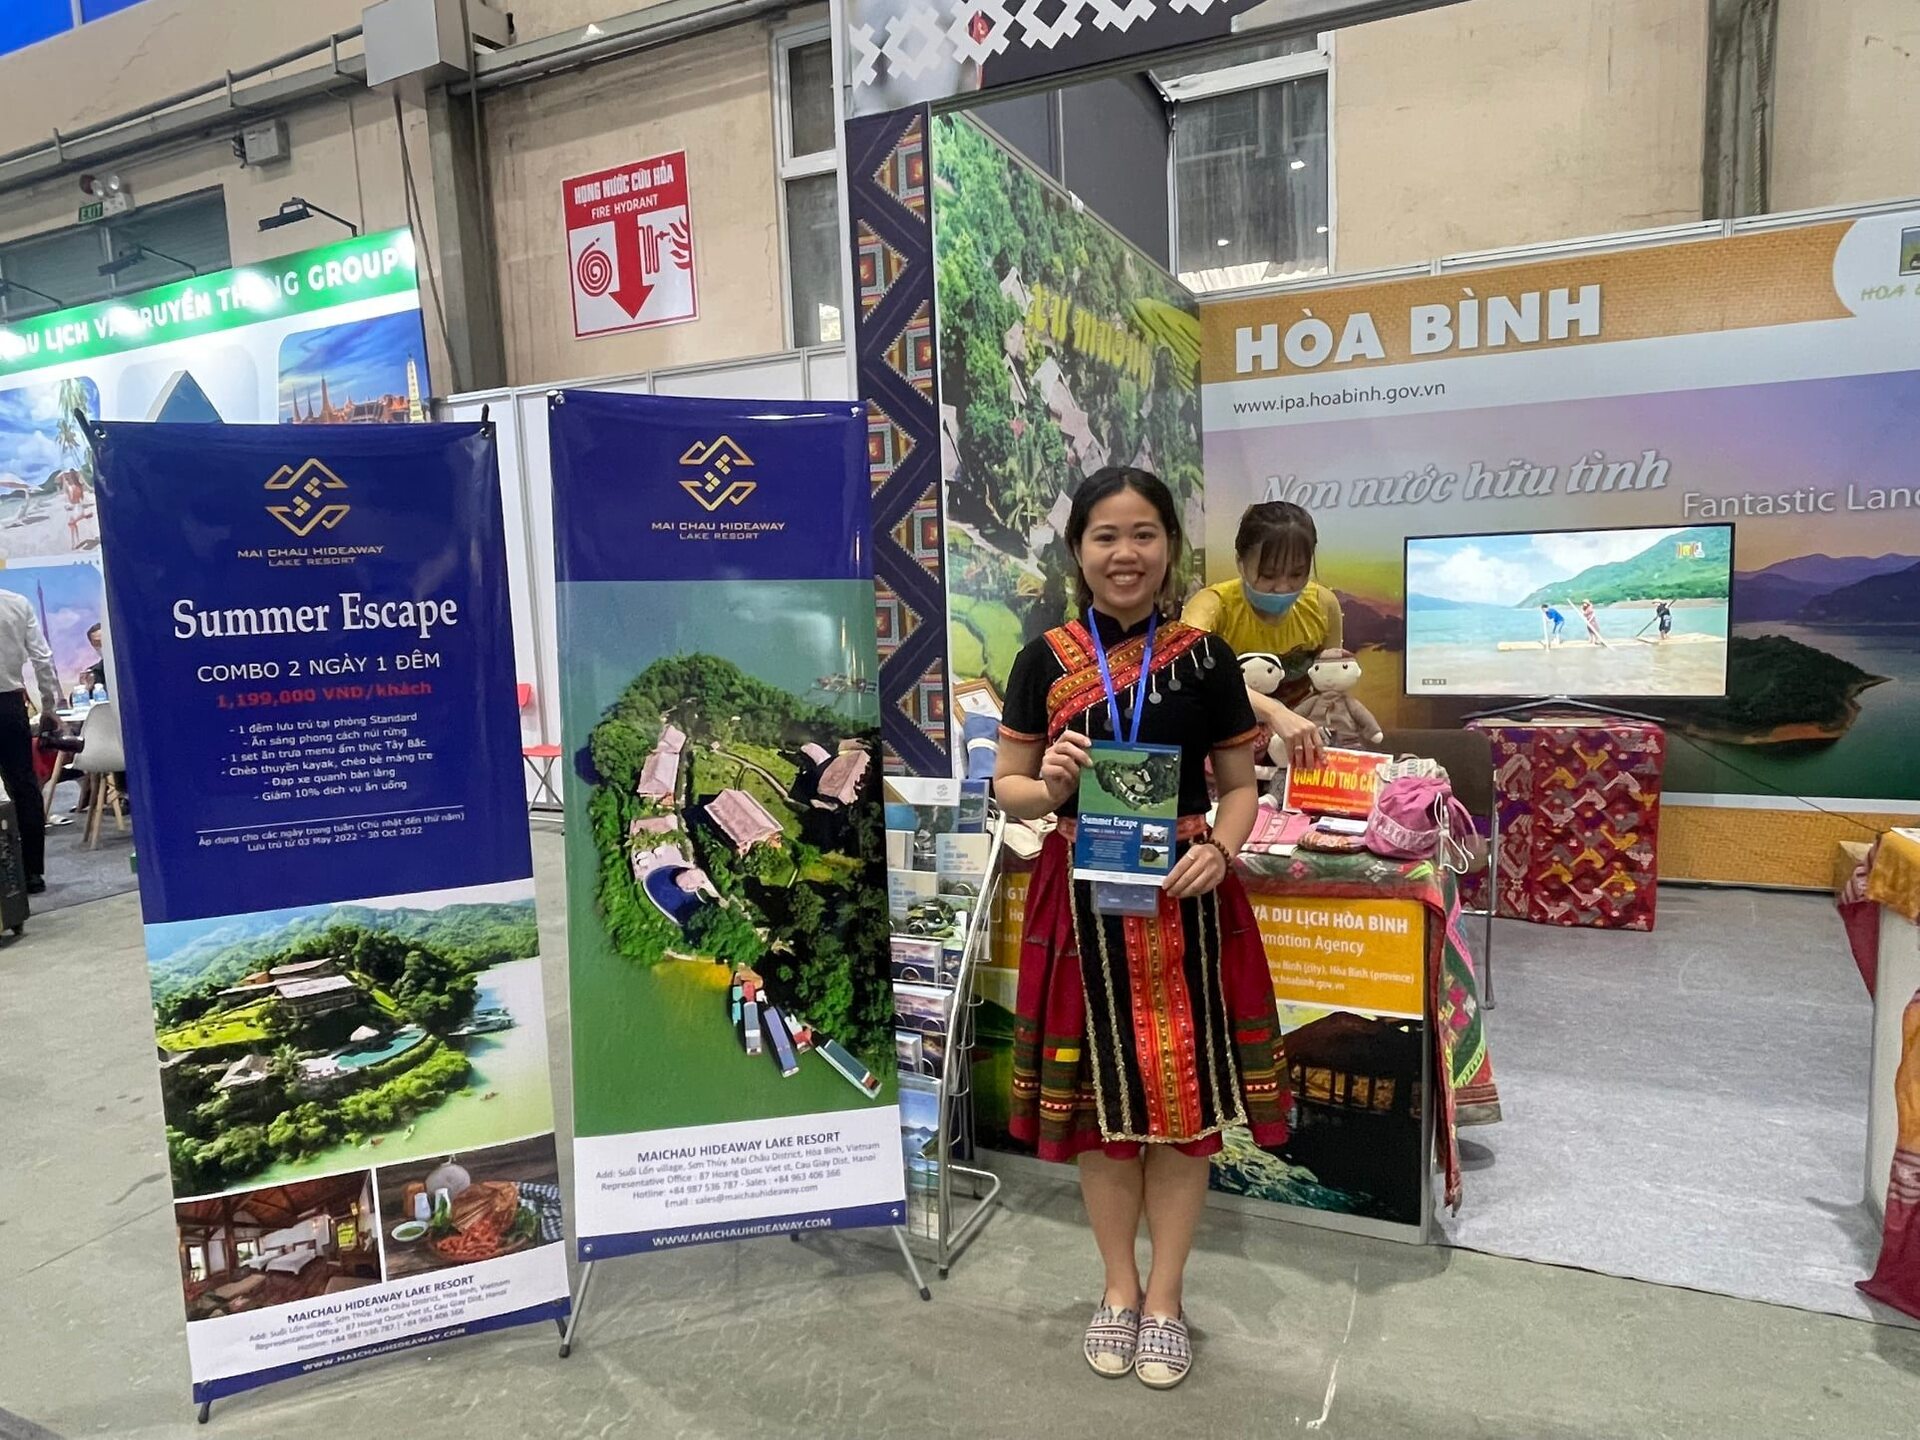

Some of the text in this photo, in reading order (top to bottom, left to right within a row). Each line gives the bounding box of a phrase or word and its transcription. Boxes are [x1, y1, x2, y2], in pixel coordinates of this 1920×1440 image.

[81, 204, 102, 220] EXIT
[591, 194, 658, 219] FIRE HYDRANT
[307, 247, 400, 291] GROUP
[1235, 284, 1601, 374] HÒA BÌNH
[1232, 381, 1446, 414] www.ipa.hoabinh.gov.vn
[1263, 450, 1670, 510] Non nước hữu tình
[1683, 486, 1835, 518] Fantastic
[651, 522, 786, 530] MAI CHAU HIDEAWAY
[714, 532, 760, 540] RESORT
[237, 545, 385, 559] MAI CHAU HIDEAWAY
[268, 556, 357, 567] LAKE RESORT
[172, 592, 458, 639] Summer Escape
[197, 649, 440, 683] COMBO 2 NGÀY 1 ĐÊM
[217, 688, 316, 710] 1,199,000
[369, 712, 417, 724] Standard
[299, 733, 333, 744] phong
[241, 752, 259, 761] set
[305, 747, 335, 756] menu
[297, 775, 310, 784] xe
[314, 772, 347, 784] quanh
[295, 788, 320, 798] 10%
[1081, 814, 1138, 830] Summer Escape
[335, 833, 358, 843] 2022
[400, 826, 423, 836] 2022
[1272, 907, 1292, 923] DU
[1296, 910, 1329, 929] LỊCH
[1333, 911, 1364, 931] HÒA
[1368, 914, 1408, 934] BÌNH
[1315, 936, 1364, 957] Agency
[637, 1131, 841, 1163] MAICHAU HIDEAWAY LAKE RESORT
[846, 1142, 880, 1153] Vietnam
[601, 1177, 665, 1191] Representative
[667, 1173, 692, 1184] Office
[746, 1178, 767, 1188] Sales
[665, 1198, 689, 1209] Email
[652, 1217, 832, 1247] WWW.MAICHAUHIDEAWAY.COM
[287, 1275, 475, 1324] MAICHAU HIDEAWAY LAKE RESORT
